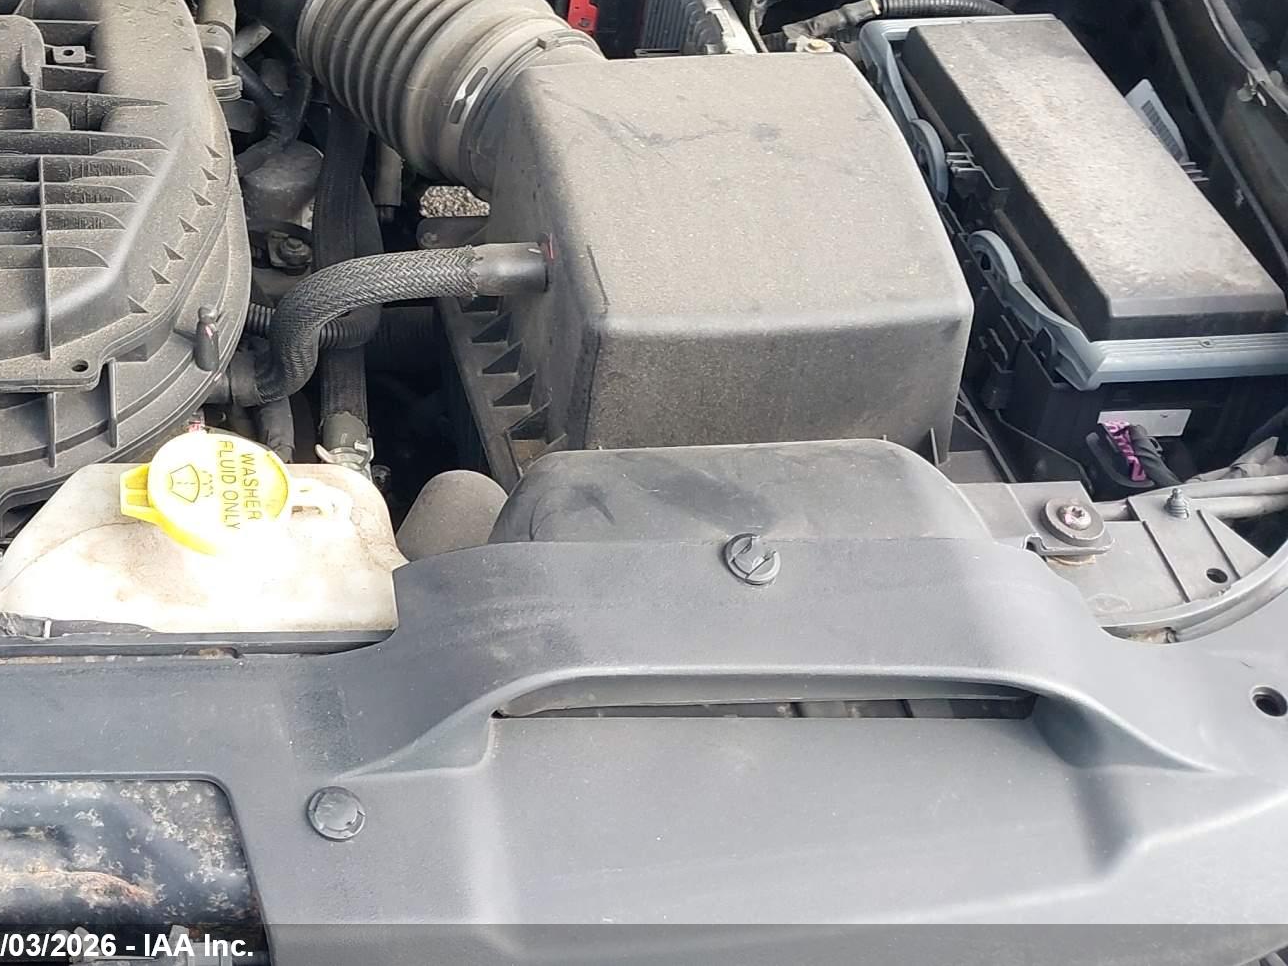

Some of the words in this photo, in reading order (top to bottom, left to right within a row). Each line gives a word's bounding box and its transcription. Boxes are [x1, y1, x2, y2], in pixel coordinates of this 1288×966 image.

[218, 440, 237, 484] FLUID
[241, 453, 262, 520] WASHER
[222, 490, 241, 530] ONLY
